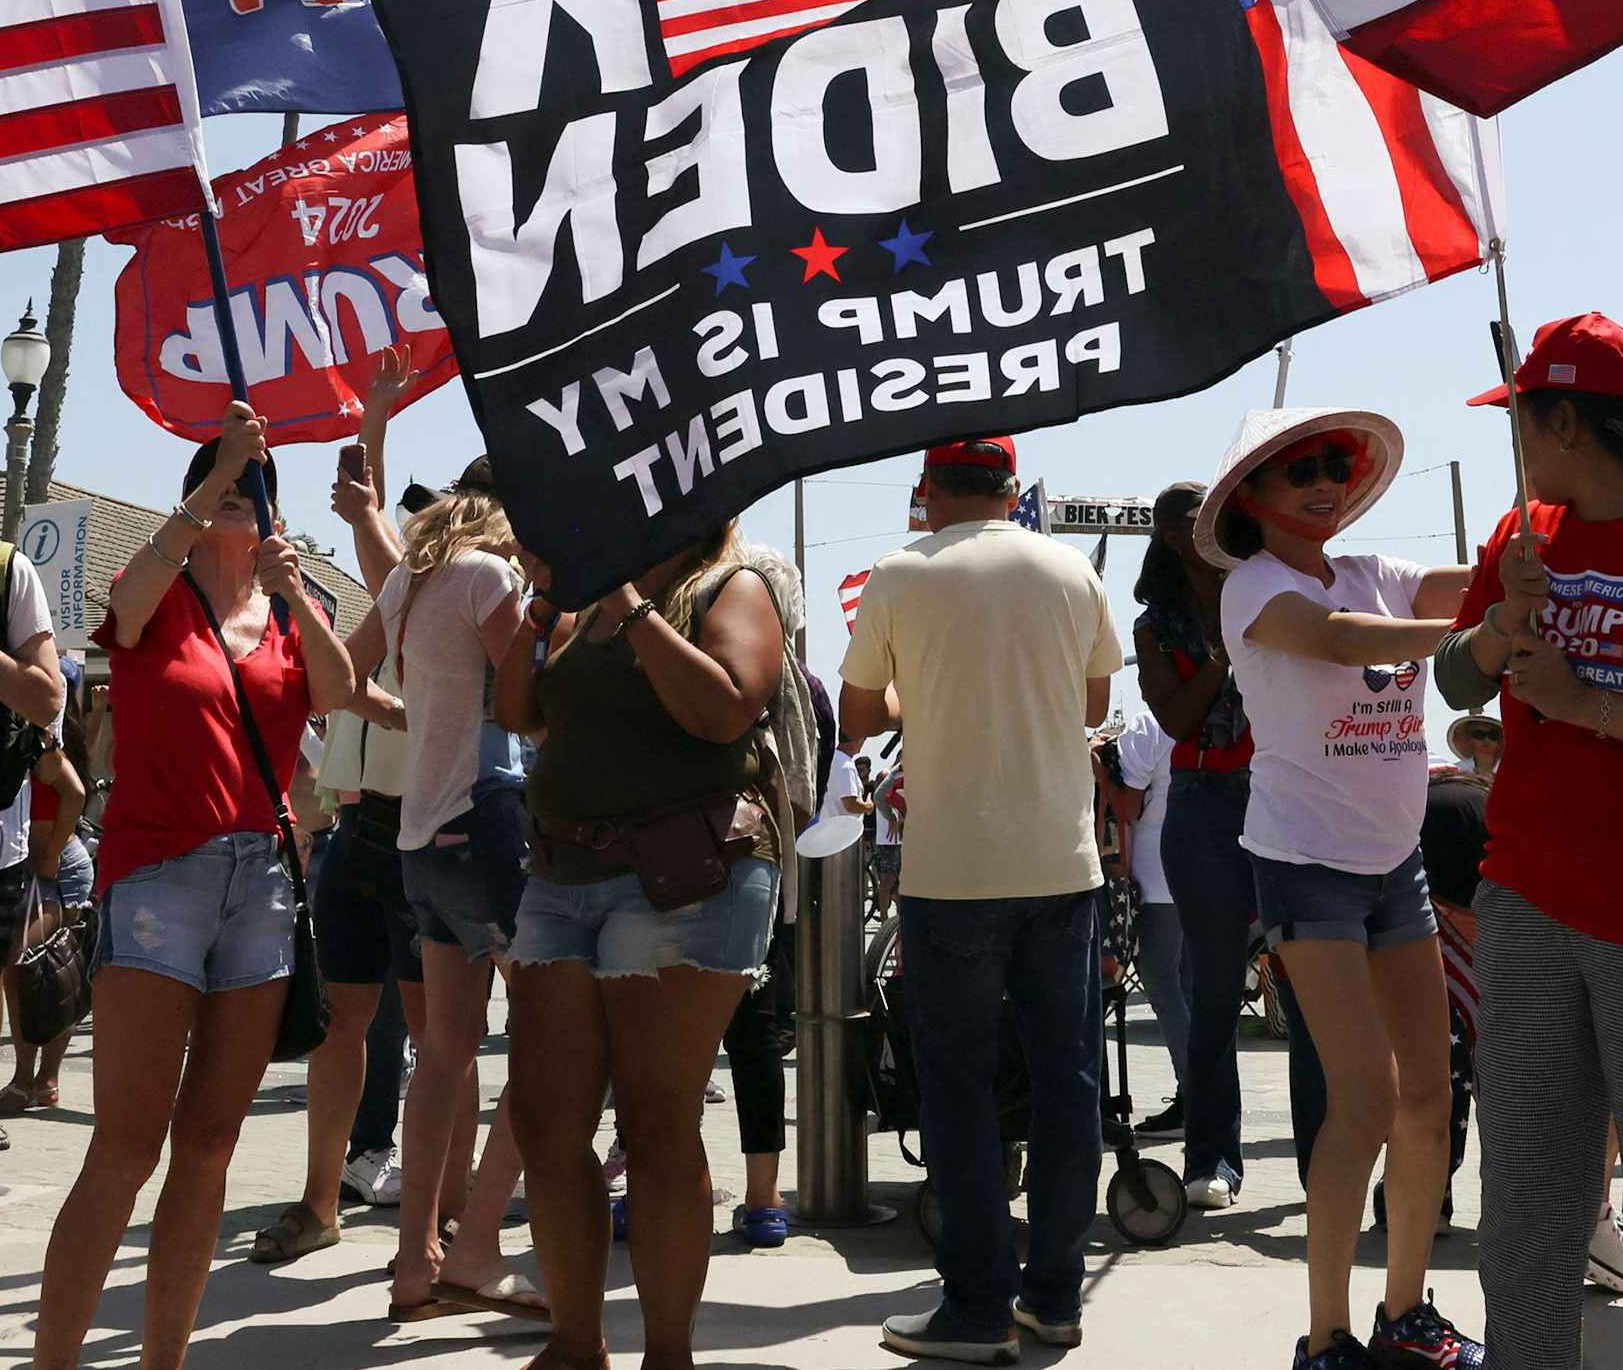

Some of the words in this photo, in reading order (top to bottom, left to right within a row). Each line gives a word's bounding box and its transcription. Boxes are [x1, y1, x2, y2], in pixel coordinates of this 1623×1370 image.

[337, 149, 413, 172] MERICA
[237, 158, 332, 207] GREAT
[290, 193, 384, 246] 2024
[159, 254, 445, 387] RUMP
[1065, 504, 1109, 524] BIER
[1114, 506, 1154, 525] FES
[73, 516, 87, 630] INFORMATION
[61, 568, 71, 631] VISITOR
[1352, 701, 1373, 714] I'm
[1376, 699, 1401, 713] Still
[1325, 715, 1391, 741] Trump
[1325, 744, 1329, 756] I
[1333, 742, 1368, 756] Make
[1371, 741, 1386, 754] No
